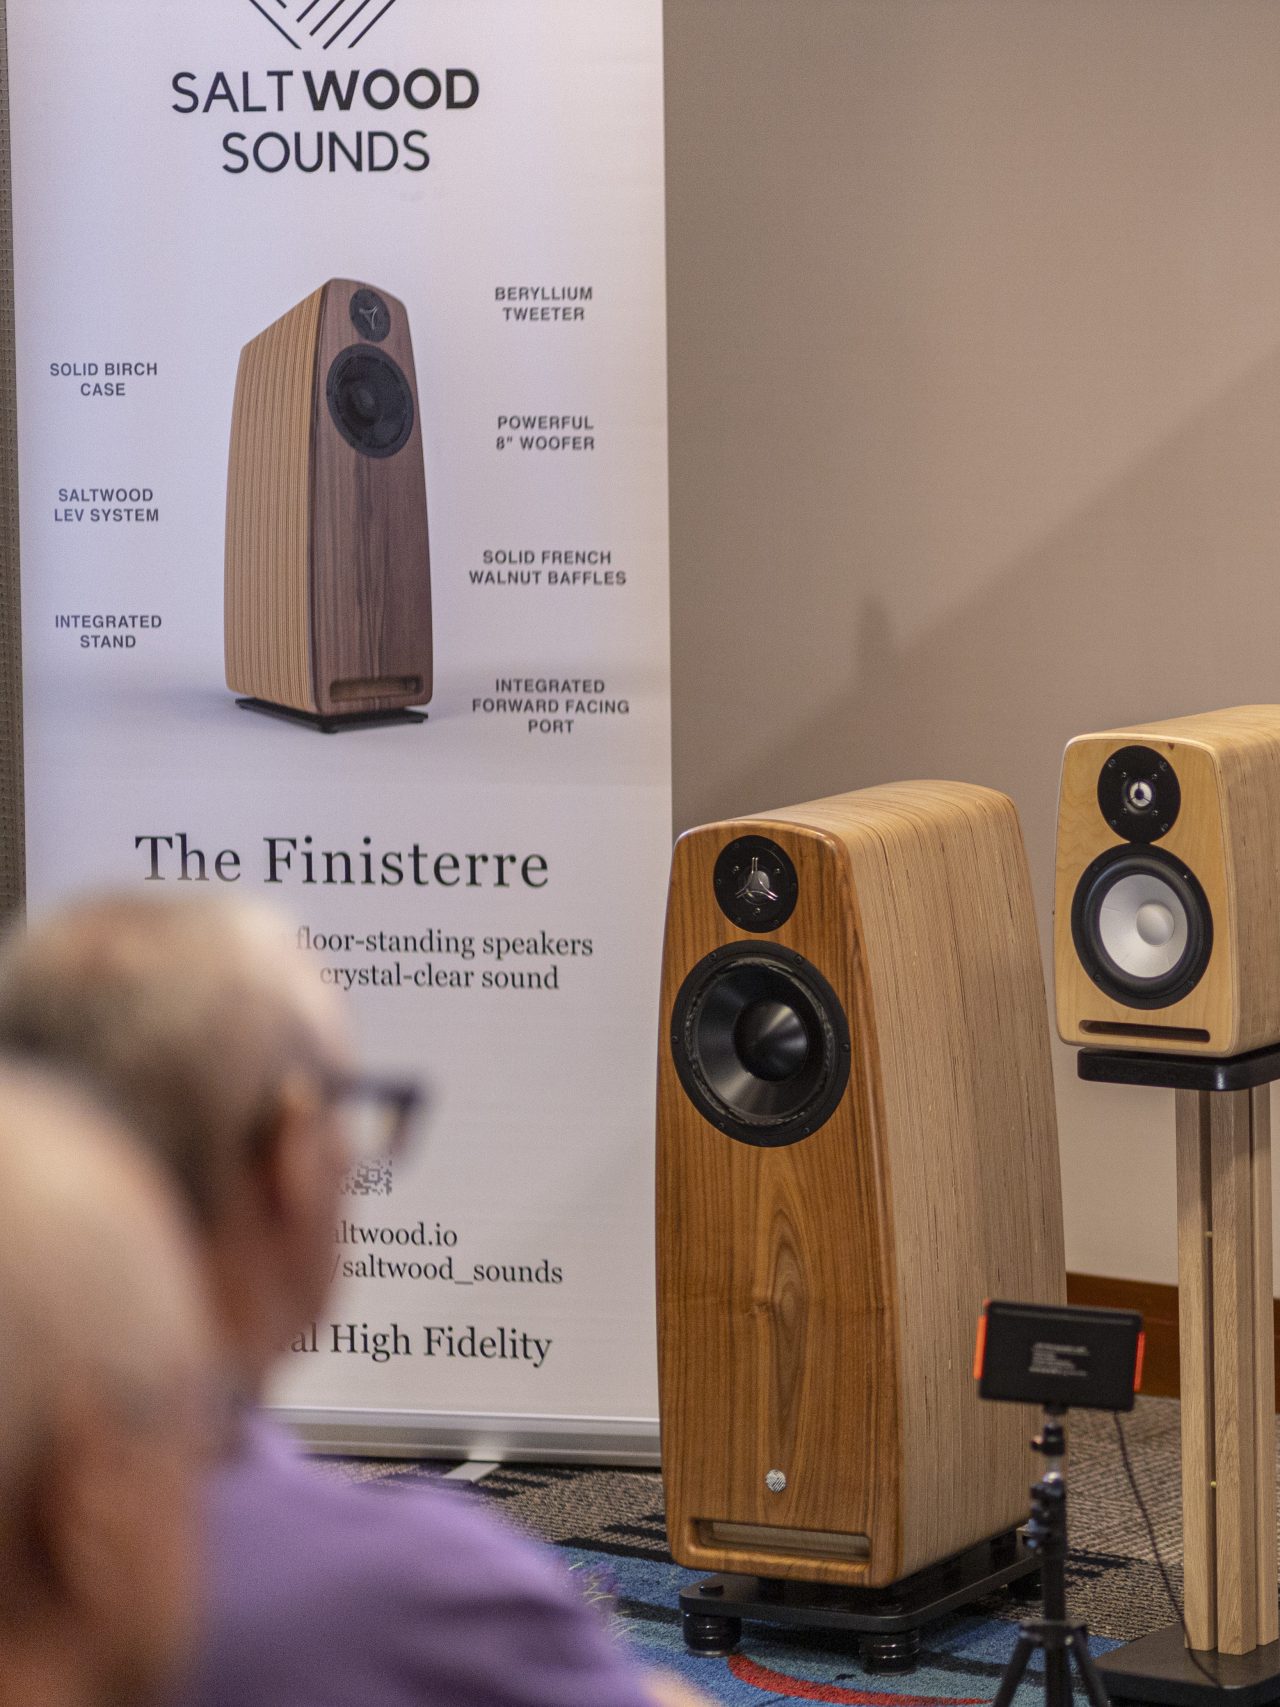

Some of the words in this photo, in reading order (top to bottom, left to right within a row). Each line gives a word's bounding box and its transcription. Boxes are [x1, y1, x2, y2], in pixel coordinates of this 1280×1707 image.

[172, 68, 479, 113] SALTWOOD
[223, 130, 430, 174] SOUNDS
[495, 287, 592, 301] BERYLLIUM
[503, 307, 584, 321] TWEETER
[50, 363, 98, 376] SOLID
[105, 362, 157, 376] BIRCH
[81, 382, 125, 396] CASE
[498, 416, 593, 430] POWERFUL
[496, 436, 512, 450] 8"
[520, 436, 594, 450] WOOFER
[59, 488, 153, 502] SALTWOOD
[55, 509, 84, 522] LEV
[91, 508, 158, 522] SYSTEM
[483, 550, 535, 564] SOLID
[542, 551, 611, 565] FRENCH
[469, 570, 541, 585] WALNUT
[548, 571, 626, 585] BAFFLES
[56, 615, 161, 628] INTEGRATED
[80, 635, 136, 648] STAND
[496, 679, 605, 693] INTEGRATED
[473, 698, 559, 713] FORWARD
[566, 700, 629, 714] FACING
[528, 719, 574, 733] PORT
[135, 833, 240, 881] The
[263, 836, 548, 888] Finisterre
[296, 926, 475, 959] floor-standing
[483, 930, 593, 960] speakers
[320, 962, 474, 990] crystal-clear
[482, 965, 558, 989] sound
[291, 1323, 319, 1352] al
[331, 1323, 412, 1362] High
[424, 1326, 552, 1368] Fidelity
